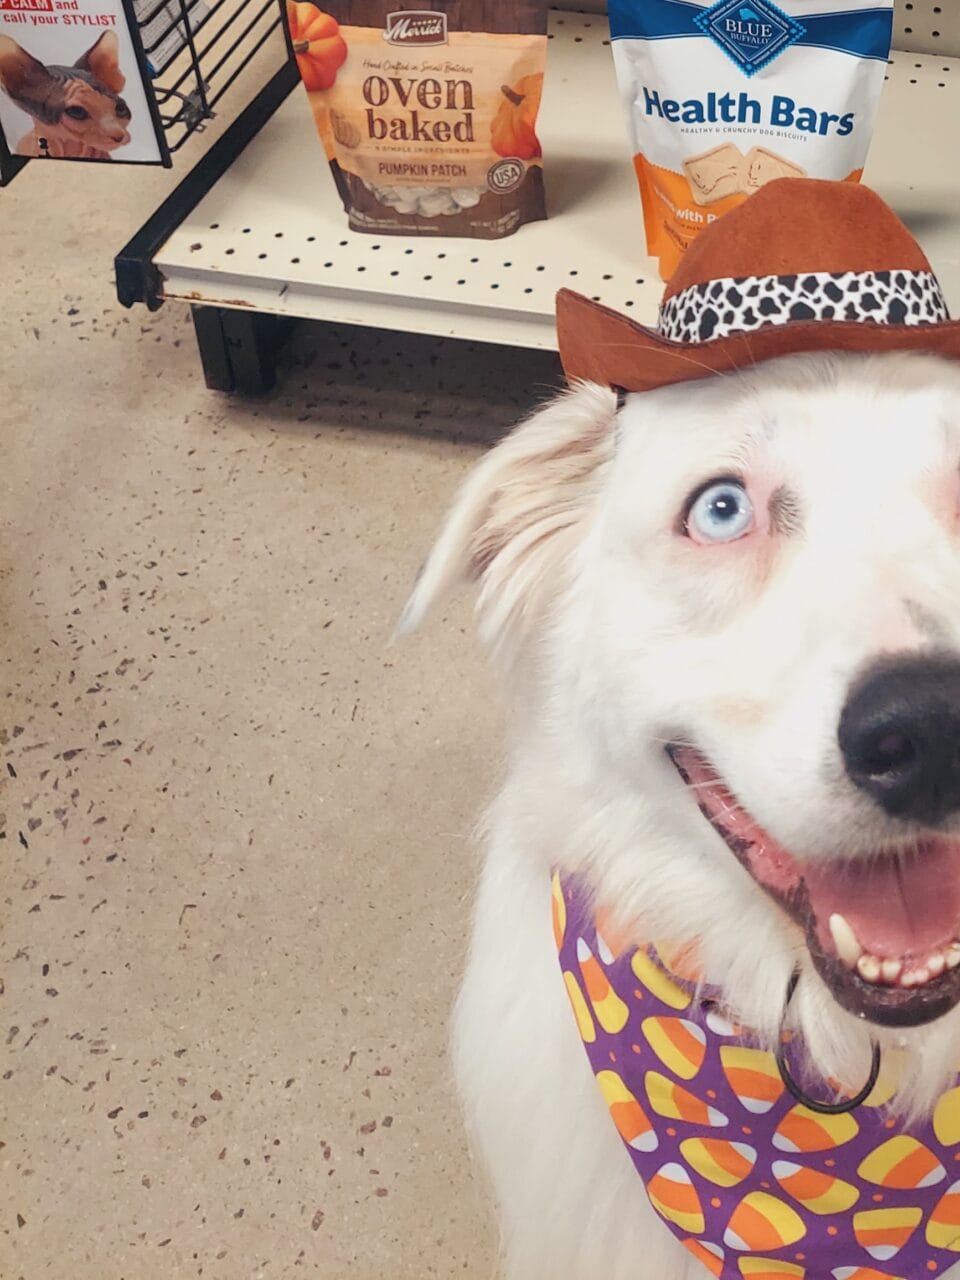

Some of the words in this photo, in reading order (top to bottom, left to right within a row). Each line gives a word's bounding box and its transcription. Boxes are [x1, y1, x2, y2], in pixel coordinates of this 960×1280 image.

[56, 0, 78, 10] and
[3, 12, 27, 23] call
[30, 15, 58, 26] your
[62, 14, 117, 26] STYLIST
[383, 18, 442, 40] Merrick
[725, 18, 773, 38] BLUE
[362, 75, 475, 110] oven
[642, 86, 761, 124] Health
[770, 94, 856, 136] Bars
[365, 108, 475, 143] baked
[759, 128, 774, 136] DOG
[378, 162, 429, 176] PUMPKIN
[431, 164, 467, 177] PATCH
[495, 166, 520, 186] USA
[676, 208, 703, 224] with
